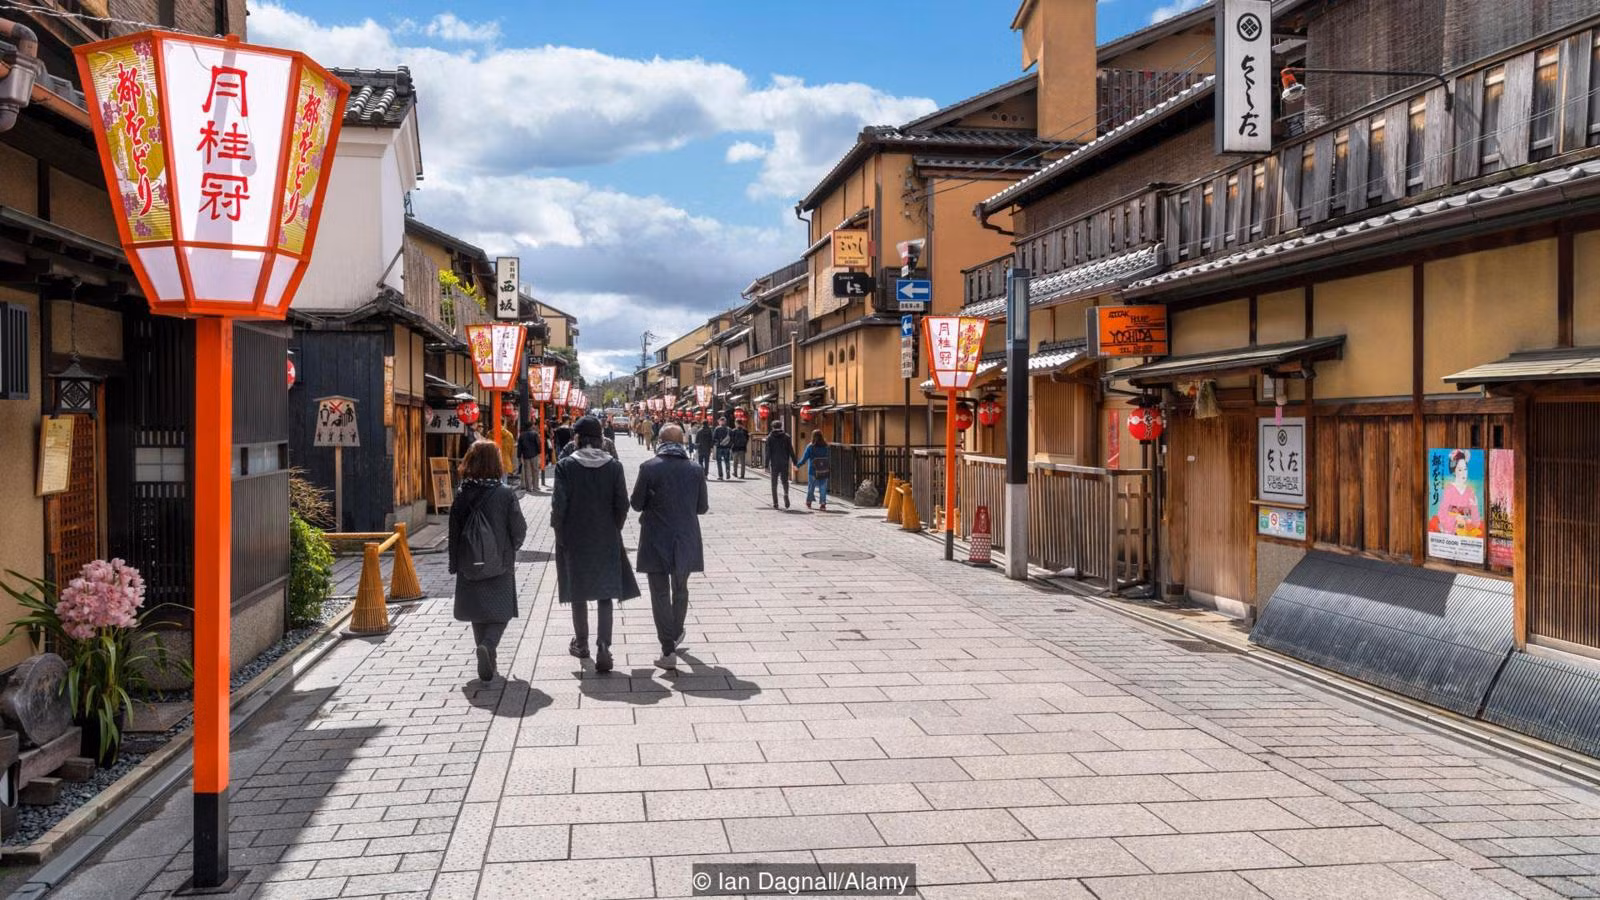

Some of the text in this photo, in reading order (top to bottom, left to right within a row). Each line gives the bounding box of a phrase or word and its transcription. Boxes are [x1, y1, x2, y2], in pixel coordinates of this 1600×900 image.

[116, 62, 153, 217] 都をどり
[196, 65, 252, 221] 月桂冠
[284, 85, 321, 225] 都をどり
[1267, 482, 1299, 491] YOSHIDA
